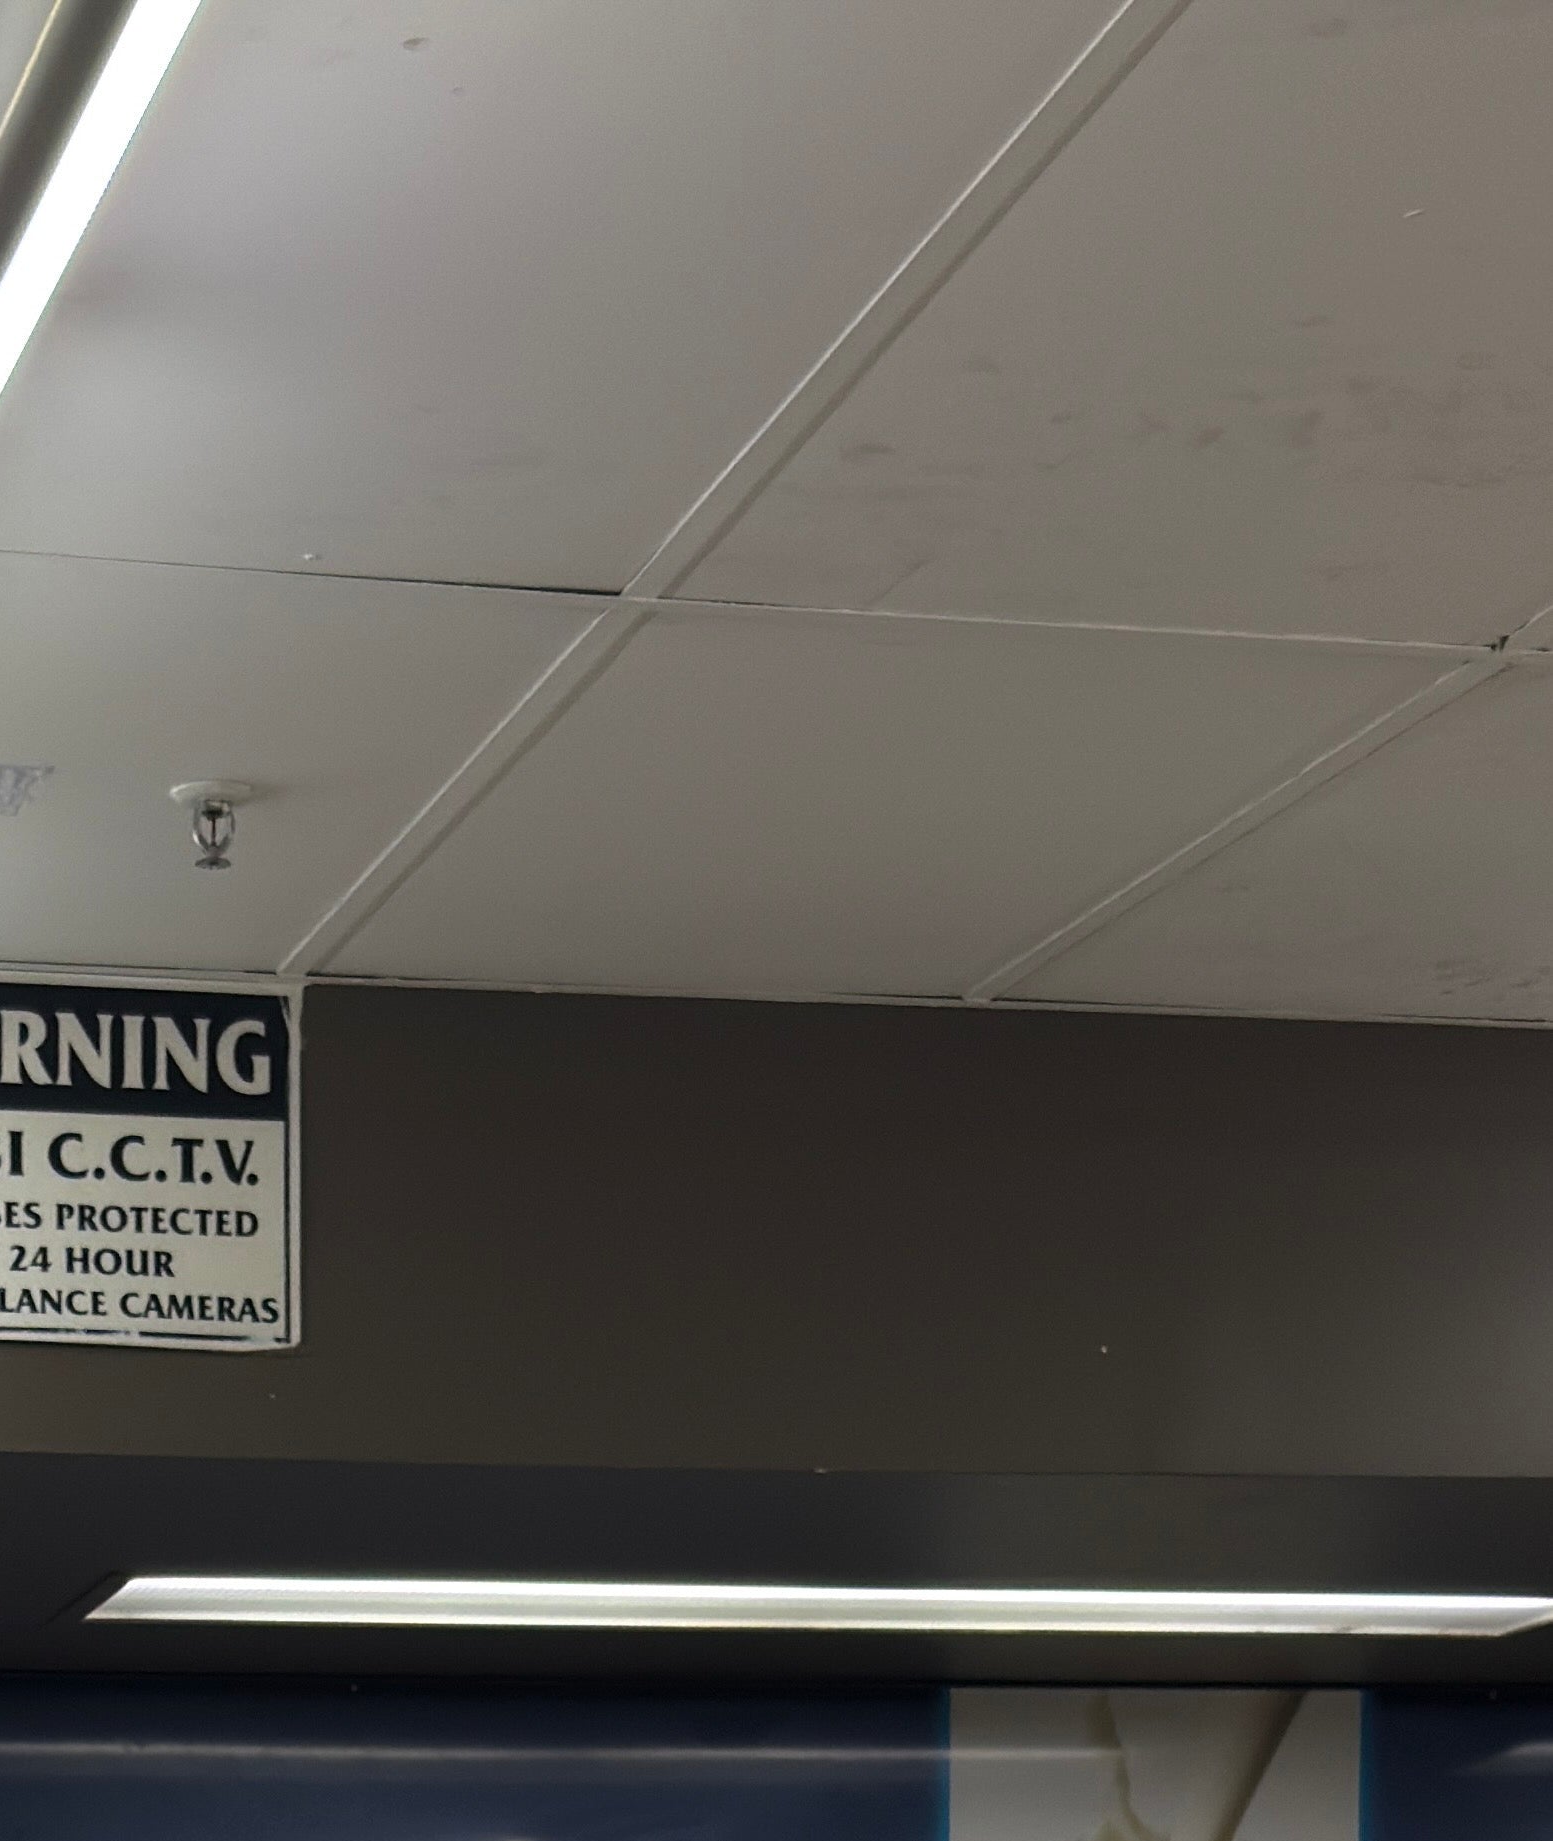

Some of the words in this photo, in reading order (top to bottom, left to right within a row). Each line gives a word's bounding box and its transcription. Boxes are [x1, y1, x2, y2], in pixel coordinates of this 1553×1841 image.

[48, 1132, 259, 1186] C.C.T.V.
[56, 1202, 259, 1237] PROTECTED
[11, 1245, 52, 1273] 24
[66, 1247, 175, 1278] HOUR
[120, 1292, 279, 1324] CAMERAS
